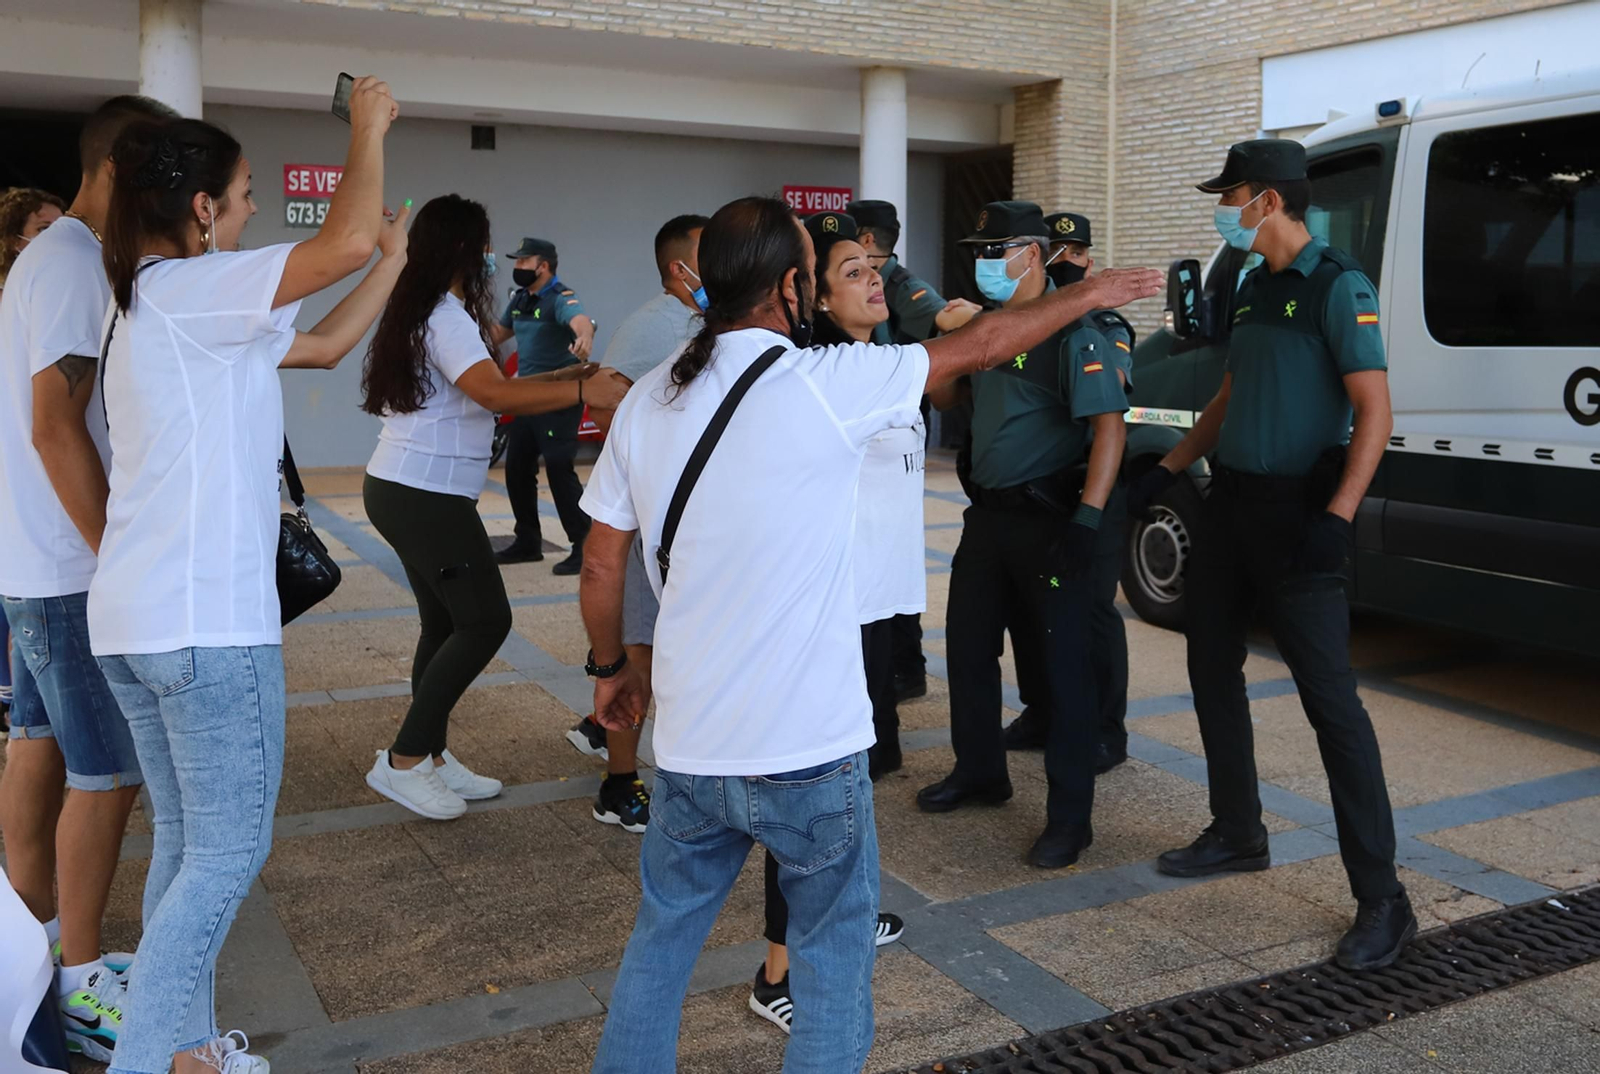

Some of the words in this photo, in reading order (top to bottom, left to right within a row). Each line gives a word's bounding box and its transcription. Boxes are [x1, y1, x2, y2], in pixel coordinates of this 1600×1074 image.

[288, 170, 310, 191] SE
[786, 191, 803, 209] SE
[805, 192, 850, 210] VENDE
[287, 202, 315, 224] 673
[316, 203, 330, 225] 5
[1563, 366, 1600, 426] G
[1163, 413, 1182, 423] CIVIL
